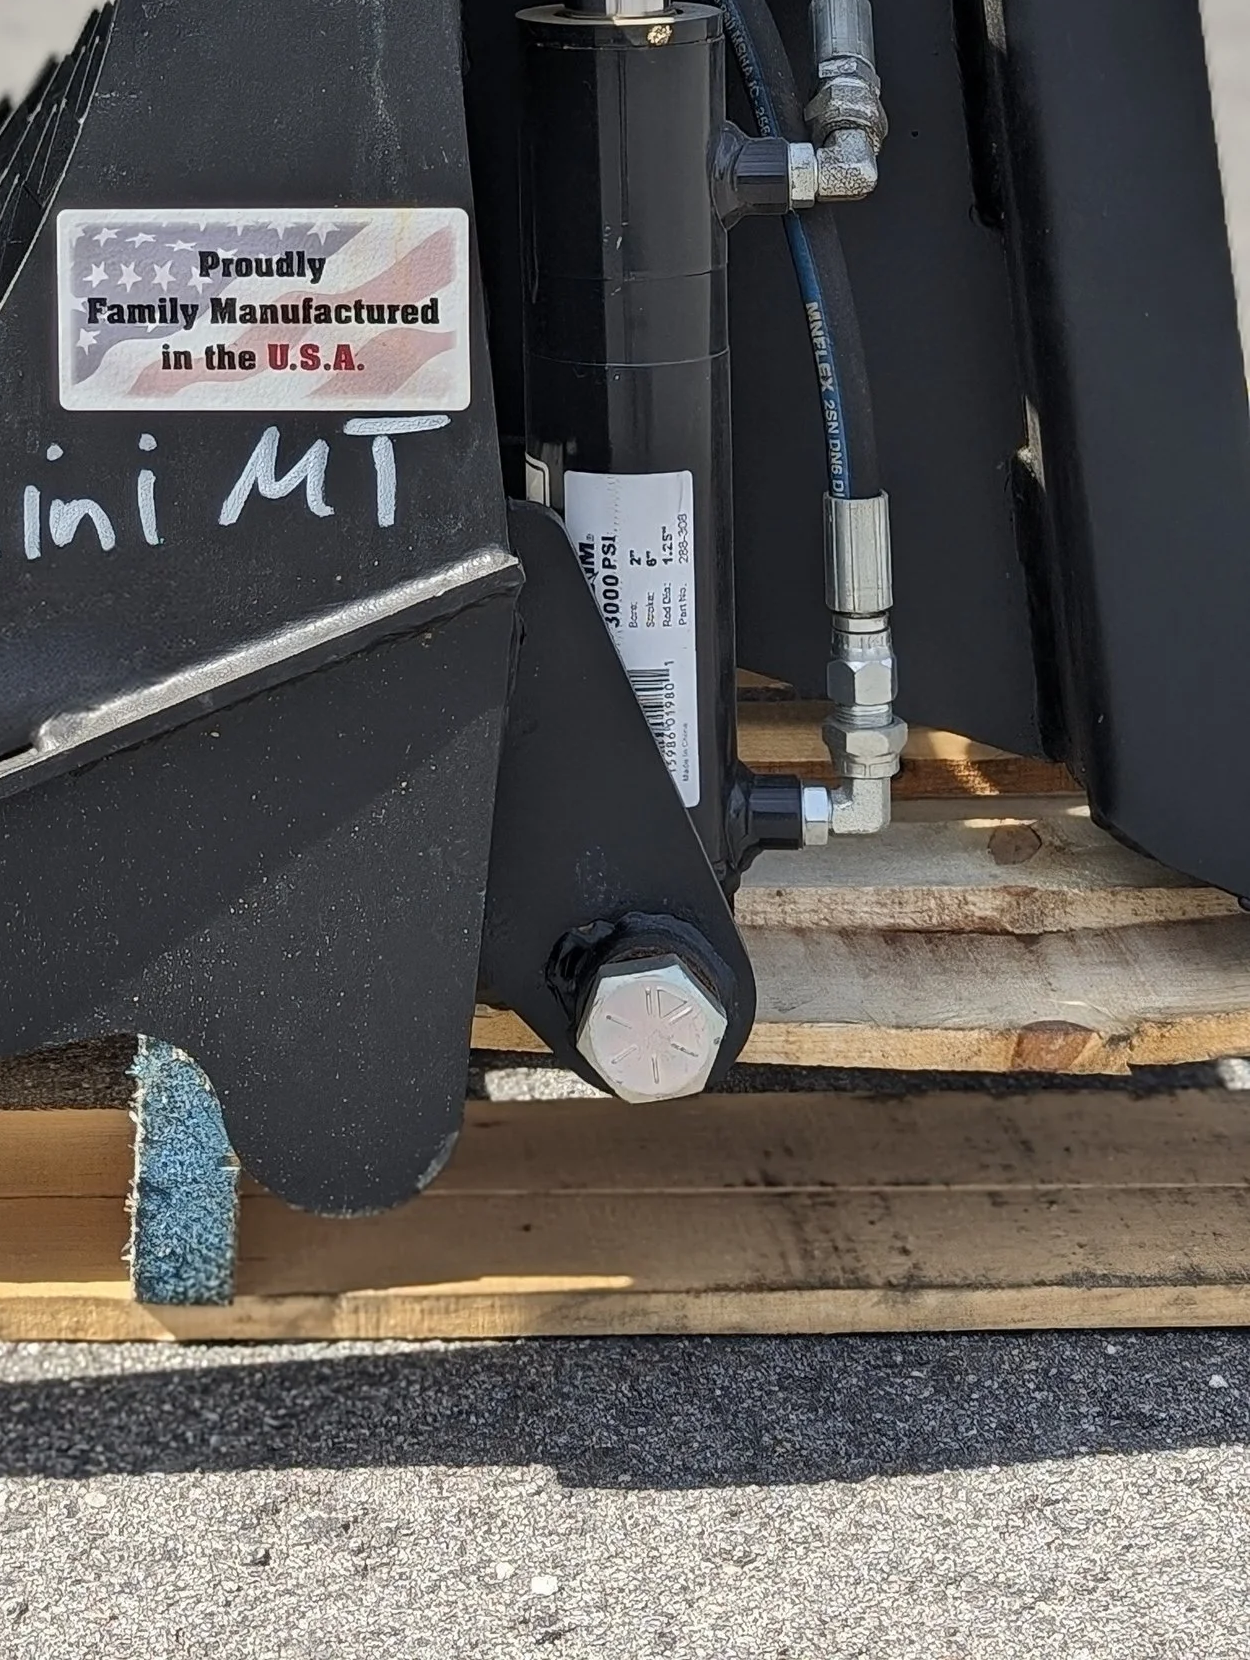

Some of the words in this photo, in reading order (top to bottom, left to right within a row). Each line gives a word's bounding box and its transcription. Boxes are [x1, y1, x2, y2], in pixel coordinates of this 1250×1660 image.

[198, 250, 327, 284] Proudly
[87, 297, 199, 330] Family
[209, 297, 440, 325] Manufactured
[161, 344, 193, 371] in
[204, 344, 257, 371] the
[267, 343, 366, 371] U.S.A.
[824, 400, 839, 434] 2SN
[218, 414, 450, 527] MT
[829, 440, 843, 475] DN6
[601, 535, 617, 570] PSI
[602, 574, 620, 628] 3000
[663, 607, 672, 627] Rod
[678, 604, 687, 626] Part
